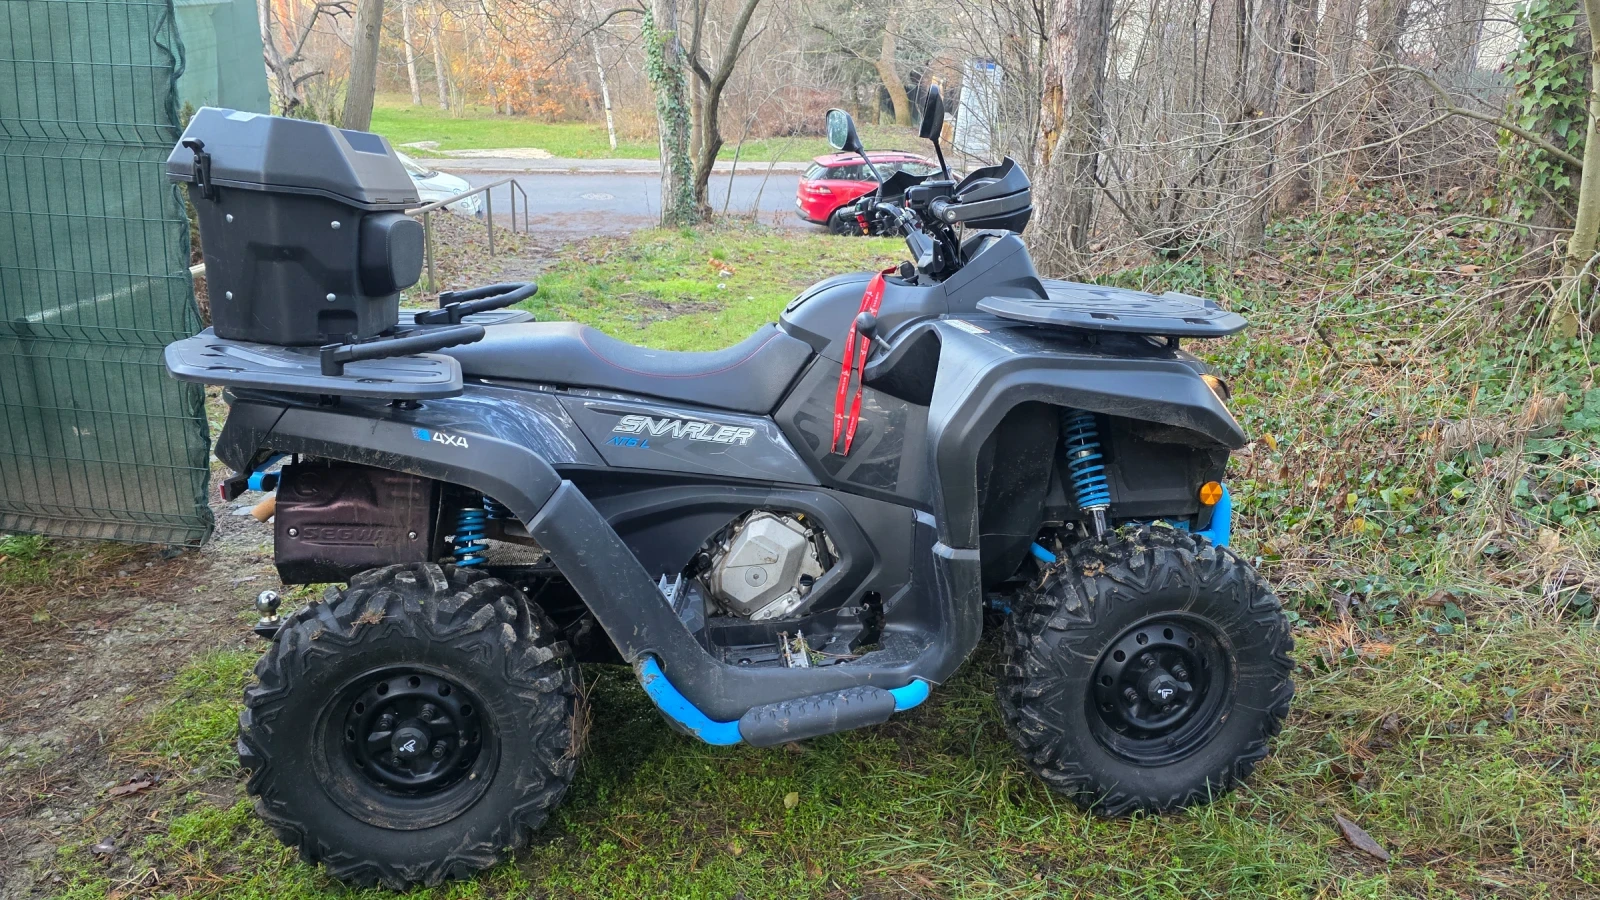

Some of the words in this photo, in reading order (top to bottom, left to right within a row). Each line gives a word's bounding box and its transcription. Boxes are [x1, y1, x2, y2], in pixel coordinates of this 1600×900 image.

[612, 414, 757, 446] SNARLER
[432, 431, 469, 449] 4X4
[605, 436, 639, 447] AT6
[640, 438, 651, 449] L
[303, 527, 407, 542] SEGWAY
